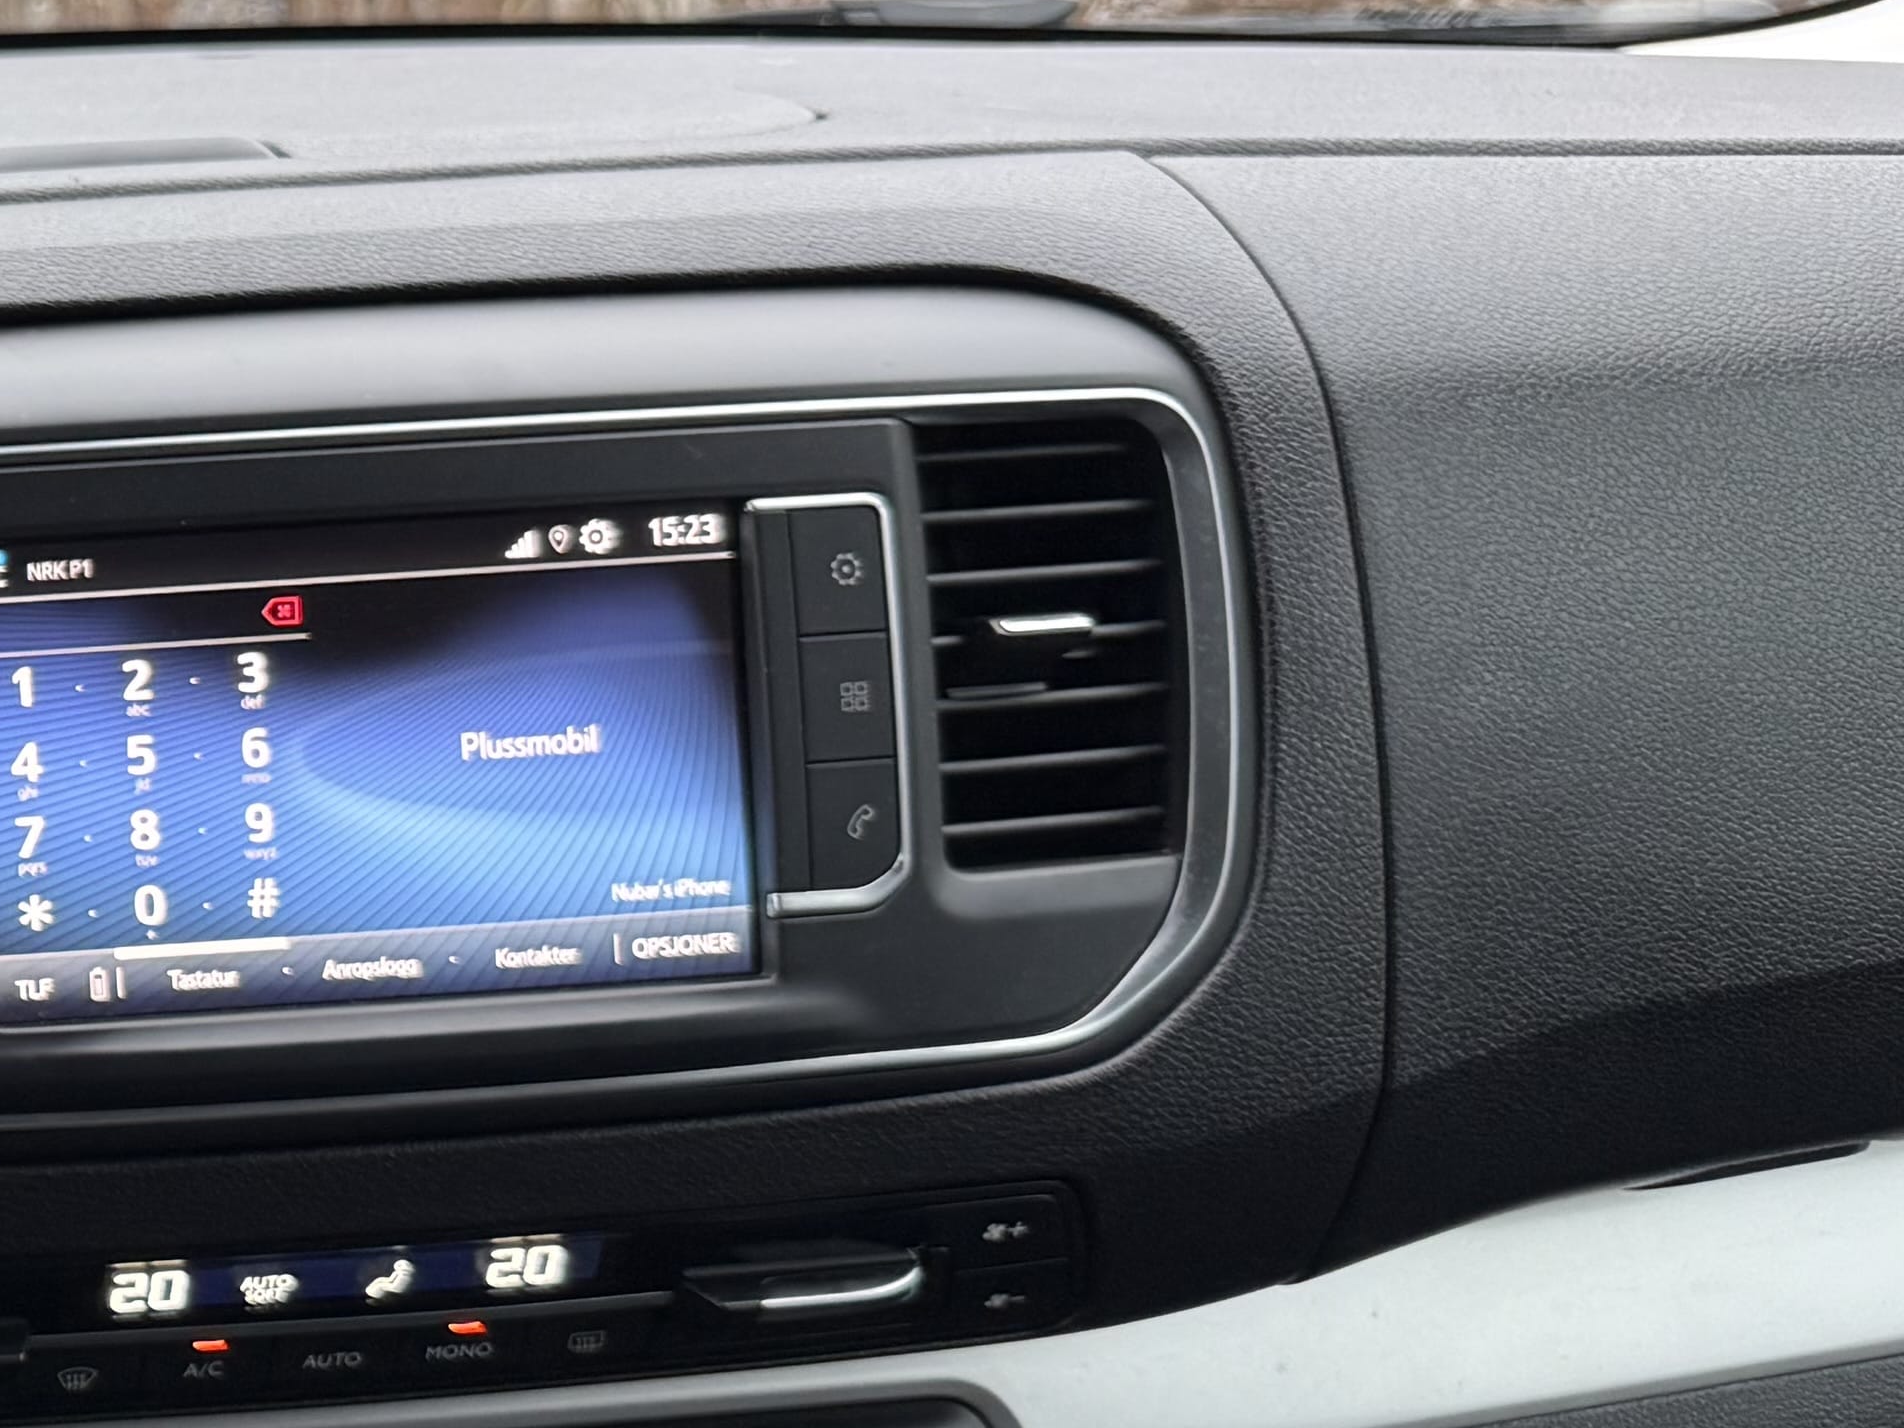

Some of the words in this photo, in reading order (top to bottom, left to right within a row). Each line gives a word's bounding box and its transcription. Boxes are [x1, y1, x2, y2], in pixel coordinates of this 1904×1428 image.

[648, 513, 725, 547] 15:23
[26, 560, 69, 581] NRK
[69, 558, 94, 580] P1
[11, 666, 34, 708] 1
[122, 659, 155, 701] 2
[237, 651, 269, 693] 3
[11, 741, 44, 783] 4
[127, 734, 157, 775] 5
[242, 727, 272, 768] 6
[460, 723, 602, 762] Plussmobil
[14, 815, 46, 859] 7
[130, 809, 161, 850] 8
[245, 802, 275, 844] 9
[134, 884, 168, 926] 0
[674, 877, 731, 899] iPhone
[632, 932, 740, 959] OPSJONER
[14, 978, 56, 1002] TLF
[167, 968, 240, 991] Tastatur
[322, 957, 422, 983] Anropslogg
[239, 1273, 299, 1293] AUTO
[485, 1244, 568, 1289] 20
[109, 1270, 190, 1314] 20
[183, 1360, 225, 1379] A/C
[302, 1351, 363, 1370] AUTO
[425, 1341, 493, 1362] MONO
